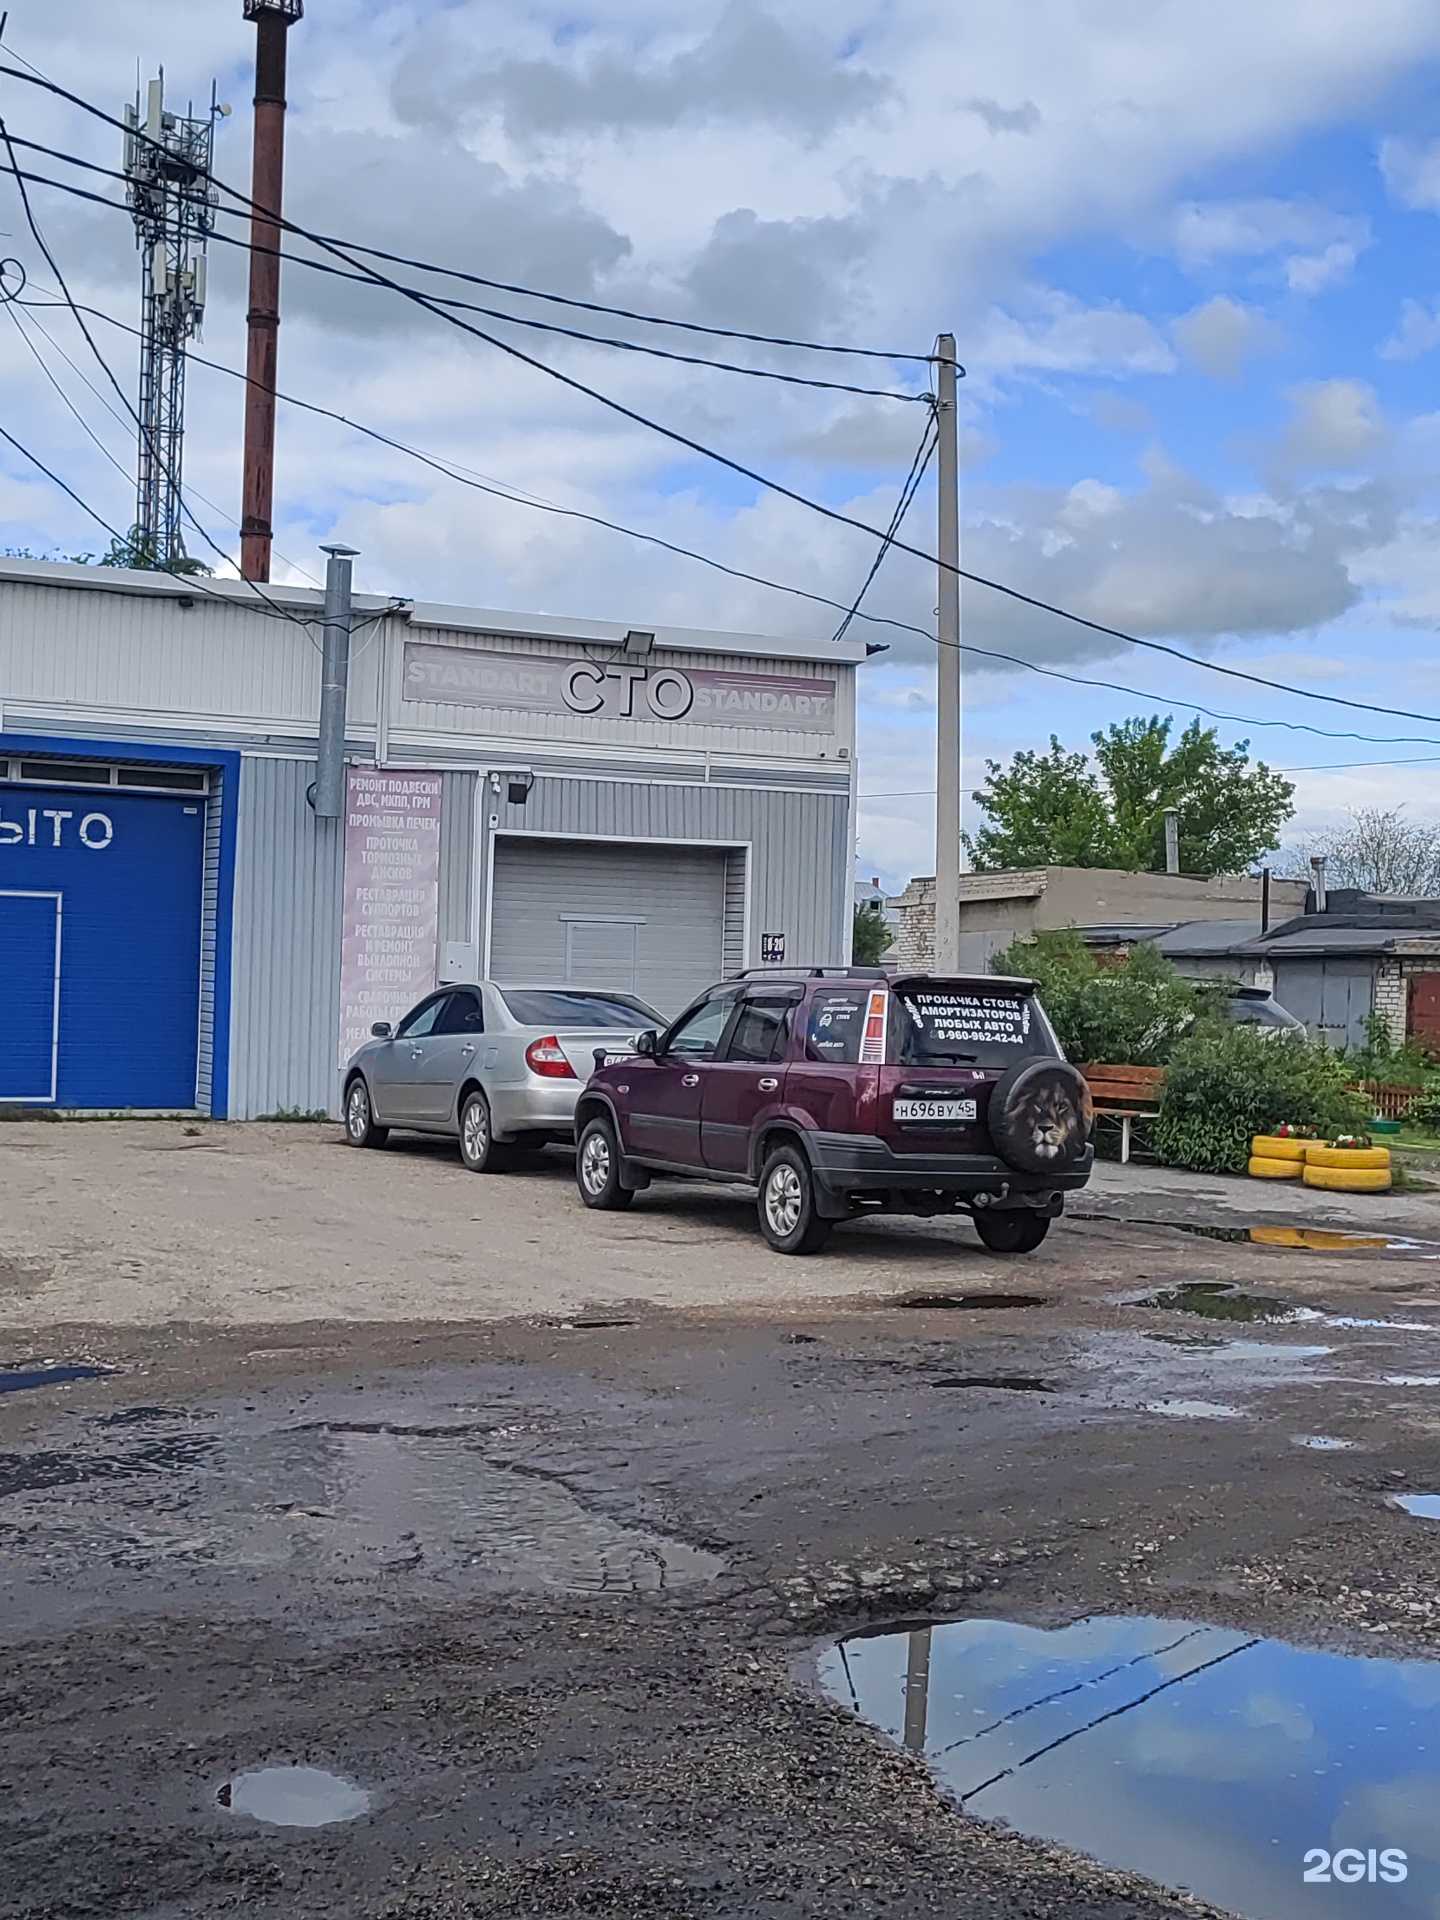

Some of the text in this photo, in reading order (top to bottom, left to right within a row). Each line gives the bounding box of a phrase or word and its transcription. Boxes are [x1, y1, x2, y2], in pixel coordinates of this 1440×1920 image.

[408, 661, 551, 696] STANDART
[560, 661, 694, 721] СТО
[699, 687, 828, 717] STANDART
[350, 778, 438, 795] РЕМОНТ ПОДВЕСКИ
[413, 796, 431, 809] ГРМ
[407, 817, 437, 830] ПЕЧЕК
[366, 837, 418, 851] ПРОТОЧКА
[371, 866, 413, 880] ДИСКОВ
[355, 924, 425, 939] РЕСТАВРАЦИЯ
[917, 995, 1020, 1009] ПРОКАЧКА СТОЕК
[921, 1006, 1021, 1021] АМОРТИЗАТОРОВ
[934, 1019, 1014, 1032] ЛЮБЫХ АВТО
[938, 1030, 1023, 1044] 8-960-962-42-44
